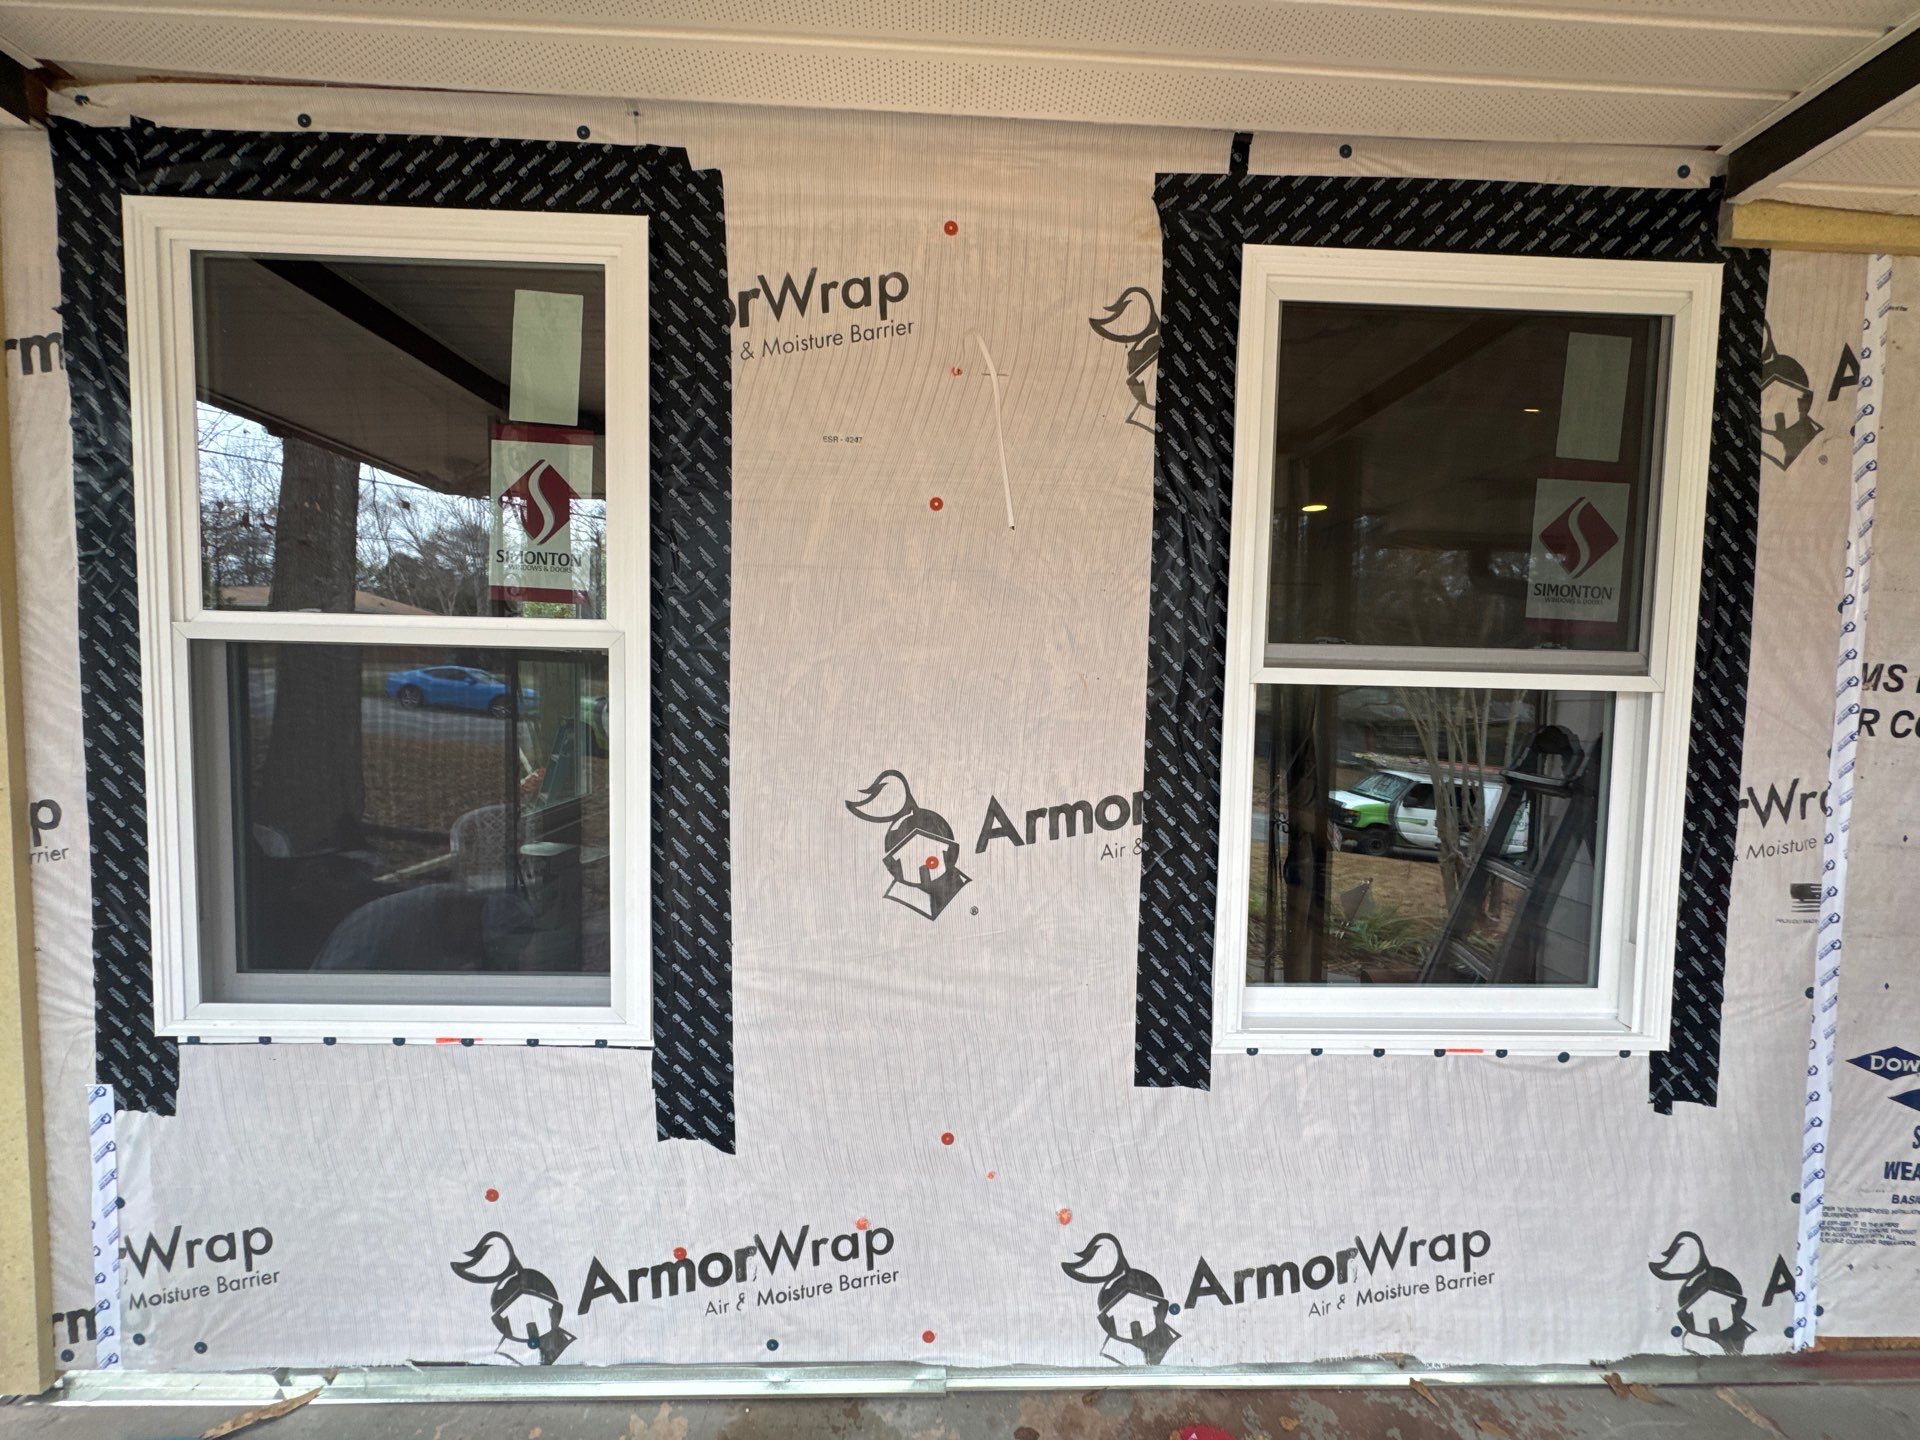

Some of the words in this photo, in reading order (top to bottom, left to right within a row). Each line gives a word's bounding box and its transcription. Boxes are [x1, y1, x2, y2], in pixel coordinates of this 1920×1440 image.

[740, 341, 755, 360] &
[762, 332, 844, 358] Moisture
[850, 320, 915, 343] Barrier
[822, 435, 839, 443] ESR
[1533, 583, 1613, 600] SIMONTON
[1857, 708, 1880, 737] R
[1890, 709, 1920, 739] C
[30, 798, 62, 848] p
[1101, 842, 1126, 861] Air
[1746, 837, 1818, 861] Moisture
[1870, 1054, 1920, 1073] DOW
[577, 1224, 895, 1316] ArmorWrap
[1184, 1226, 1492, 1310] ArmorWrap
[129, 1287, 211, 1311] Moisture
[216, 1270, 281, 1294] Barrier
[704, 1299, 729, 1317] Air
[756, 1281, 833, 1308] Moisture
[839, 1269, 900, 1292] Barrier
[1308, 1300, 1332, 1318] Air
[1356, 1282, 1430, 1307] Moisture
[1435, 1271, 1496, 1292] Barrier
